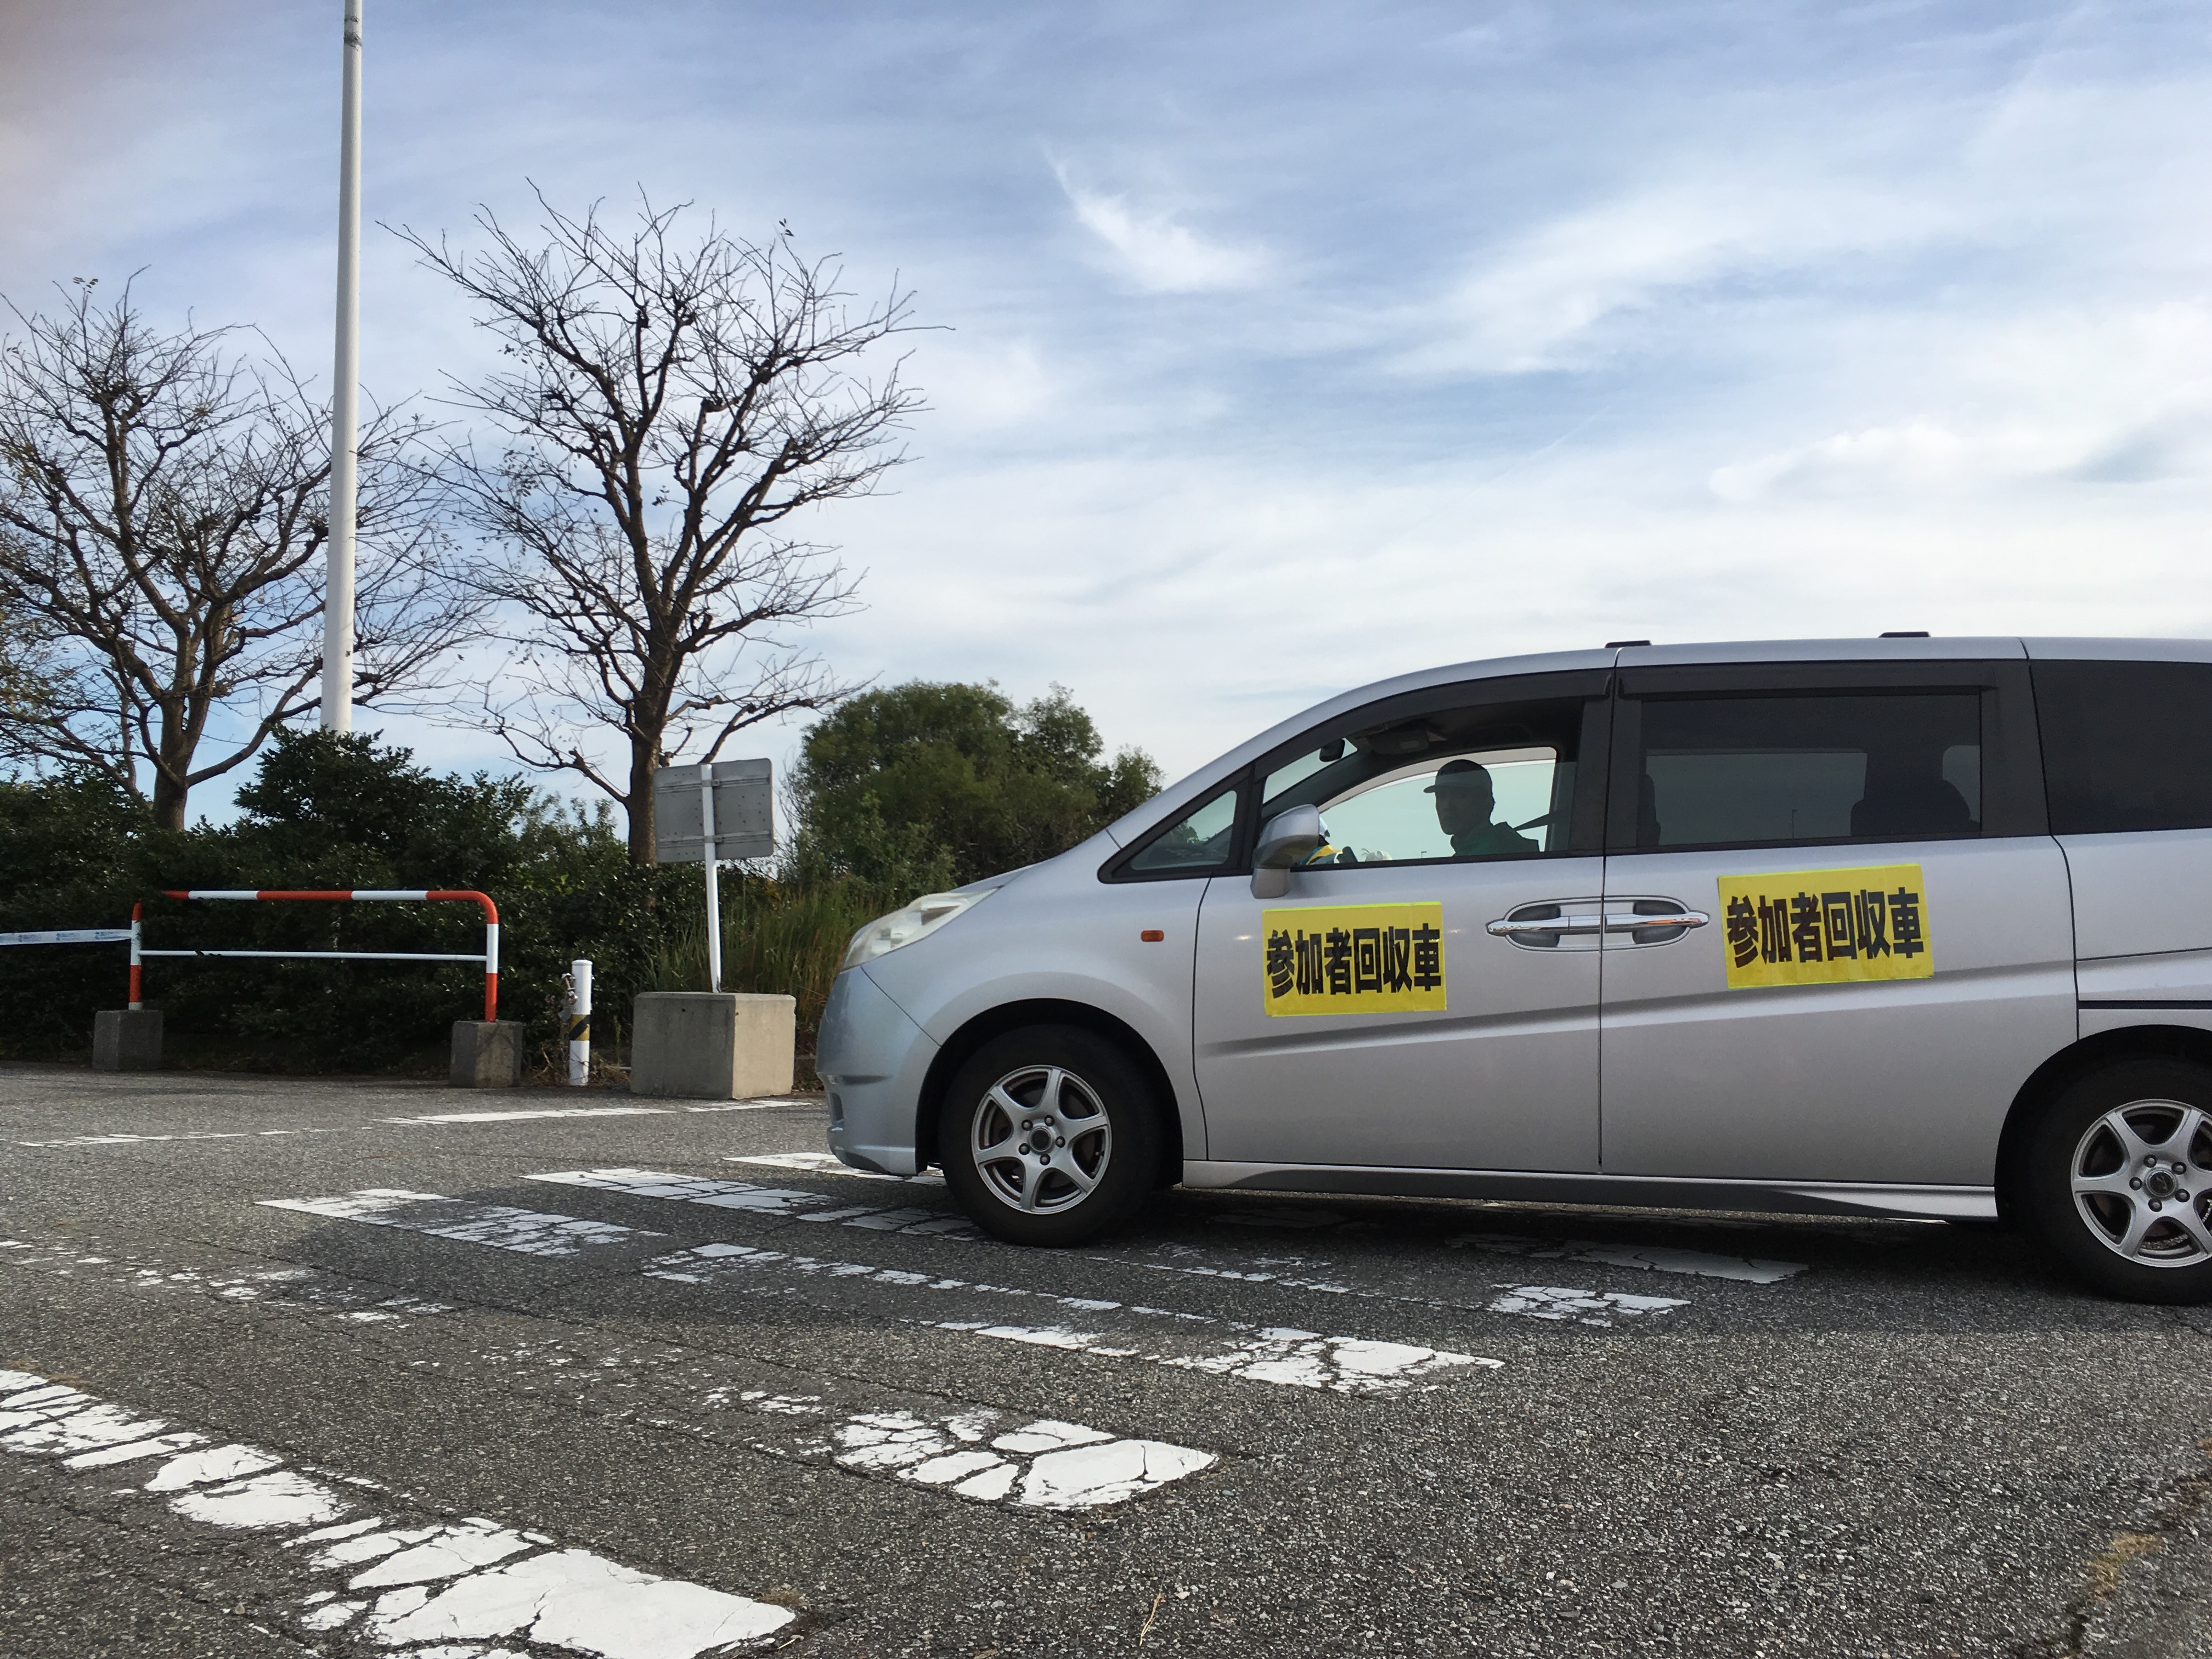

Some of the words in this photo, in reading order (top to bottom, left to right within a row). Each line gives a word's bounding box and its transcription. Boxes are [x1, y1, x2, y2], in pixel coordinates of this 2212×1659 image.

[1267, 923, 1442, 999] 参加者回収車
[1726, 887, 1925, 968] 参加者回収車
